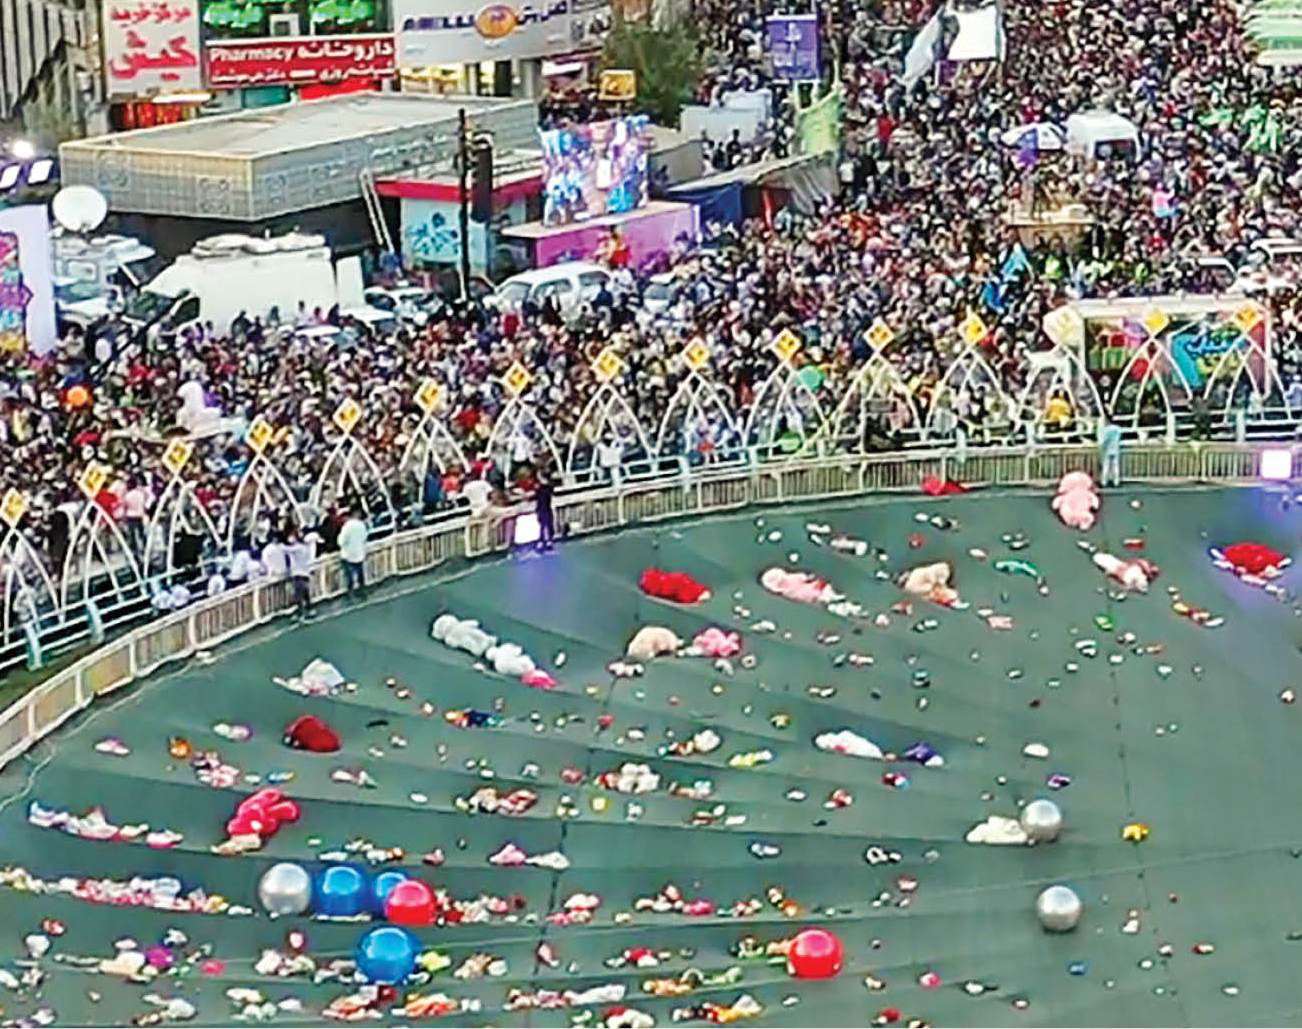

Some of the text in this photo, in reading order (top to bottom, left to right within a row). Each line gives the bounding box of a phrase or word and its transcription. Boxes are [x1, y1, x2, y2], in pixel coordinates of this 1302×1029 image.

[109, 30, 198, 81] کیش
[209, 46, 295, 63] Pharmacy
[297, 39, 394, 61] داروخانه
